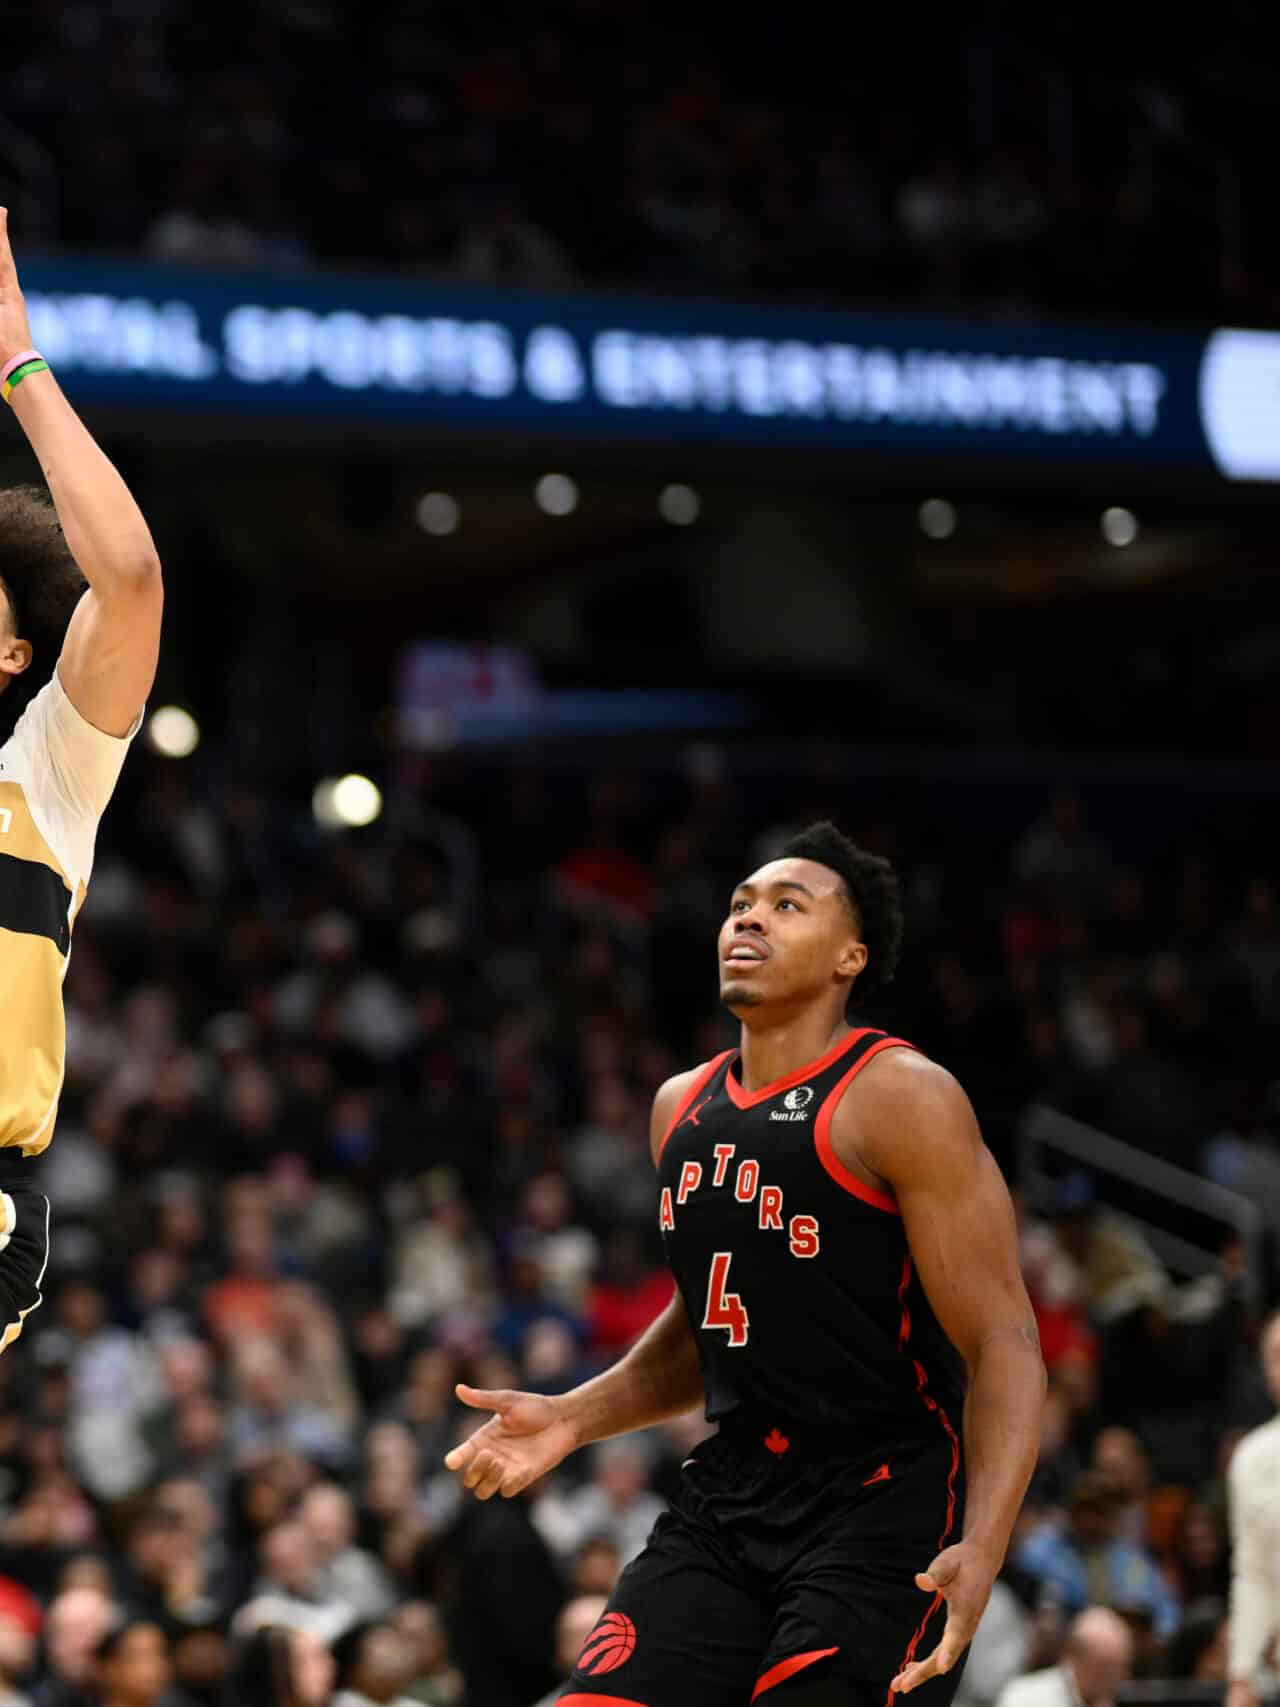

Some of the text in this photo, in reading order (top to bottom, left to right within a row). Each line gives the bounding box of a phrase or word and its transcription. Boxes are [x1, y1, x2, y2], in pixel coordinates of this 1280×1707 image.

[224, 306, 515, 398] SPORTS
[524, 326, 583, 402] &
[592, 330, 1164, 436] ENTERTAINMENT
[768, 1110, 808, 1121] Sun Life
[659, 1143, 819, 1258] APTORS
[701, 1251, 750, 1348] 4
